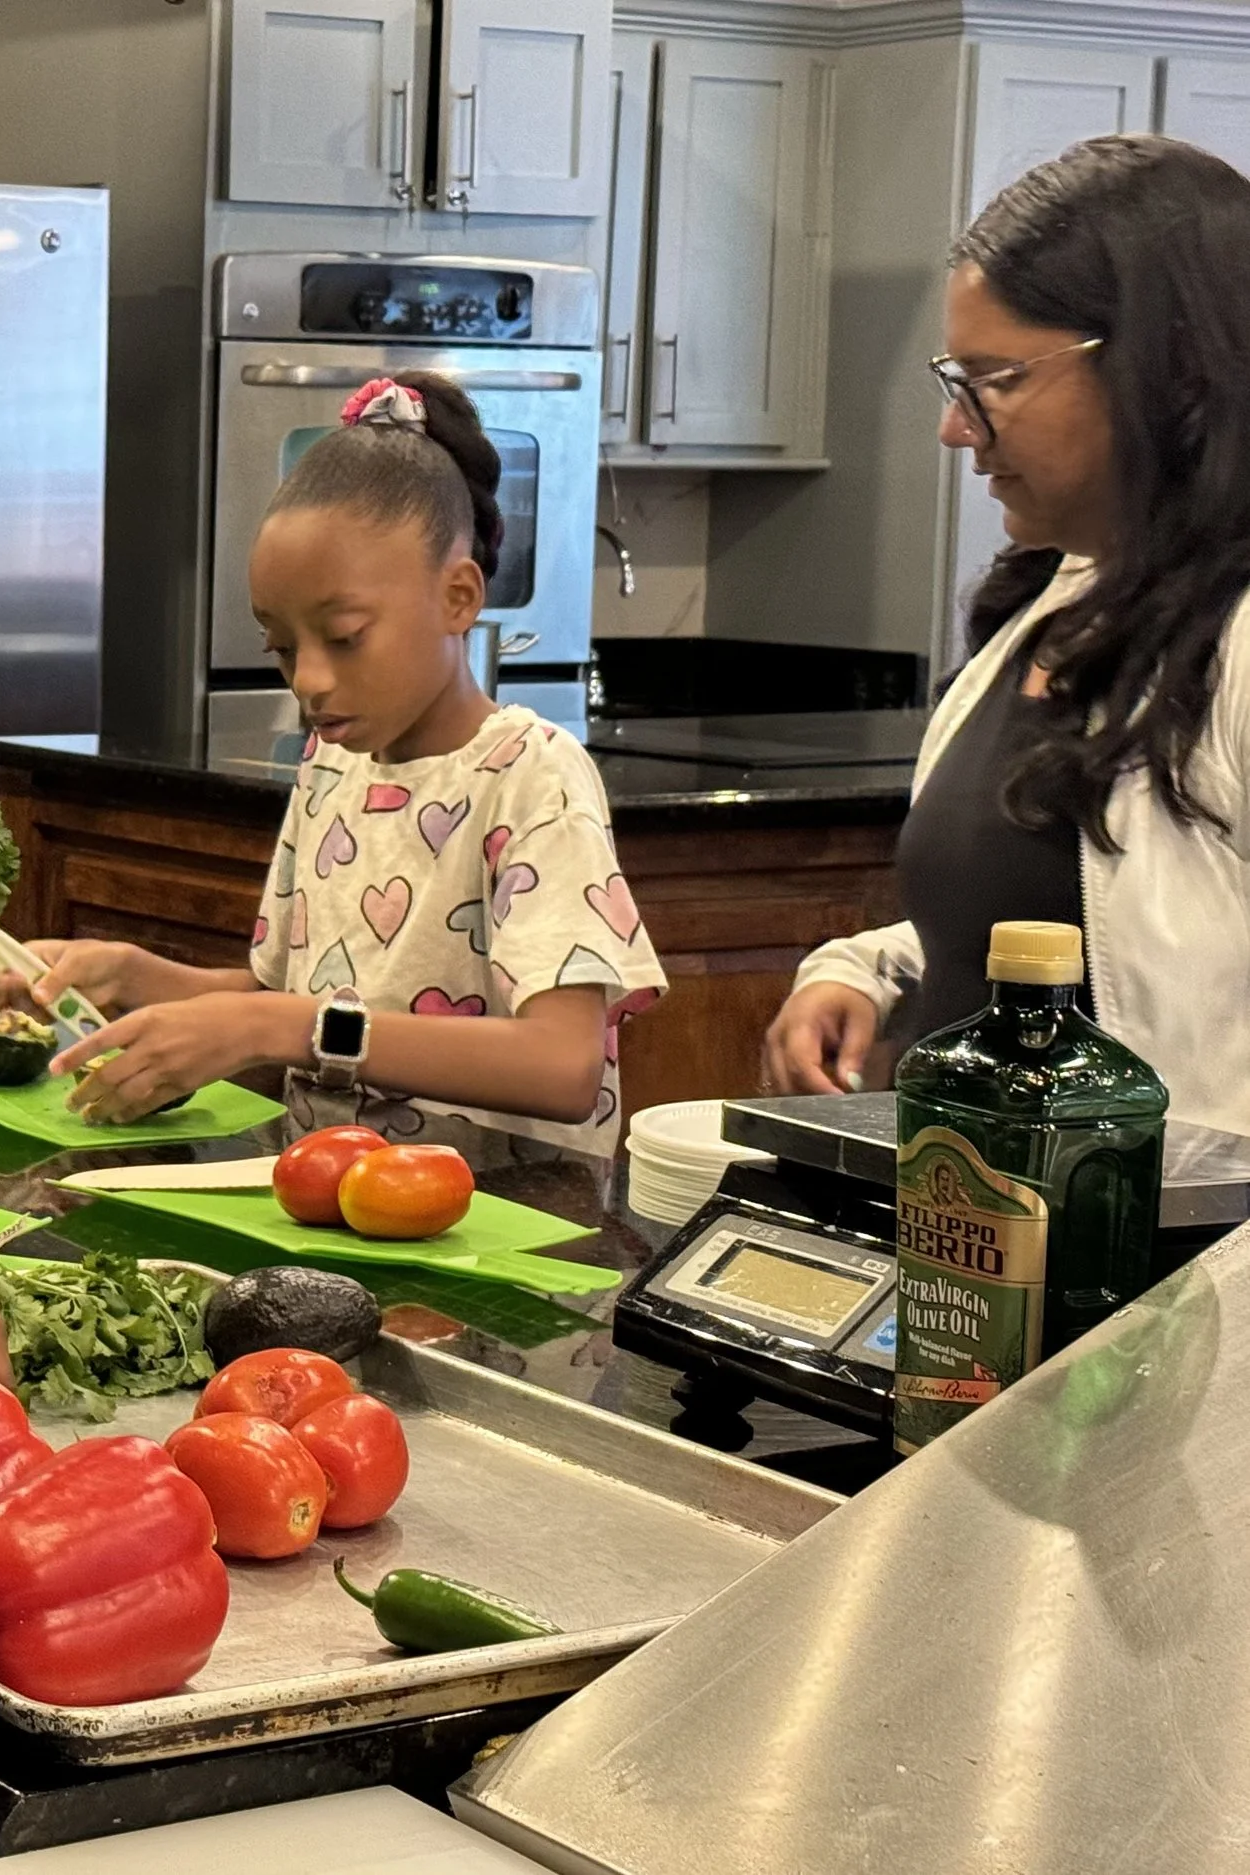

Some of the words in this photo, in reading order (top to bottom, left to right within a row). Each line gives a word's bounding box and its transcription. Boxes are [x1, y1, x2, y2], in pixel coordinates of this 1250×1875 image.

[747, 1224, 783, 1241] CAS
[900, 1200, 996, 1245] FILIPPO
[897, 1220, 1004, 1276] BERIO
[899, 1267, 938, 1303] EXTRA
[937, 1277, 990, 1320] VIRGIN
[907, 1300, 948, 1332] OLIVE
[950, 1309, 981, 1341] OIL
